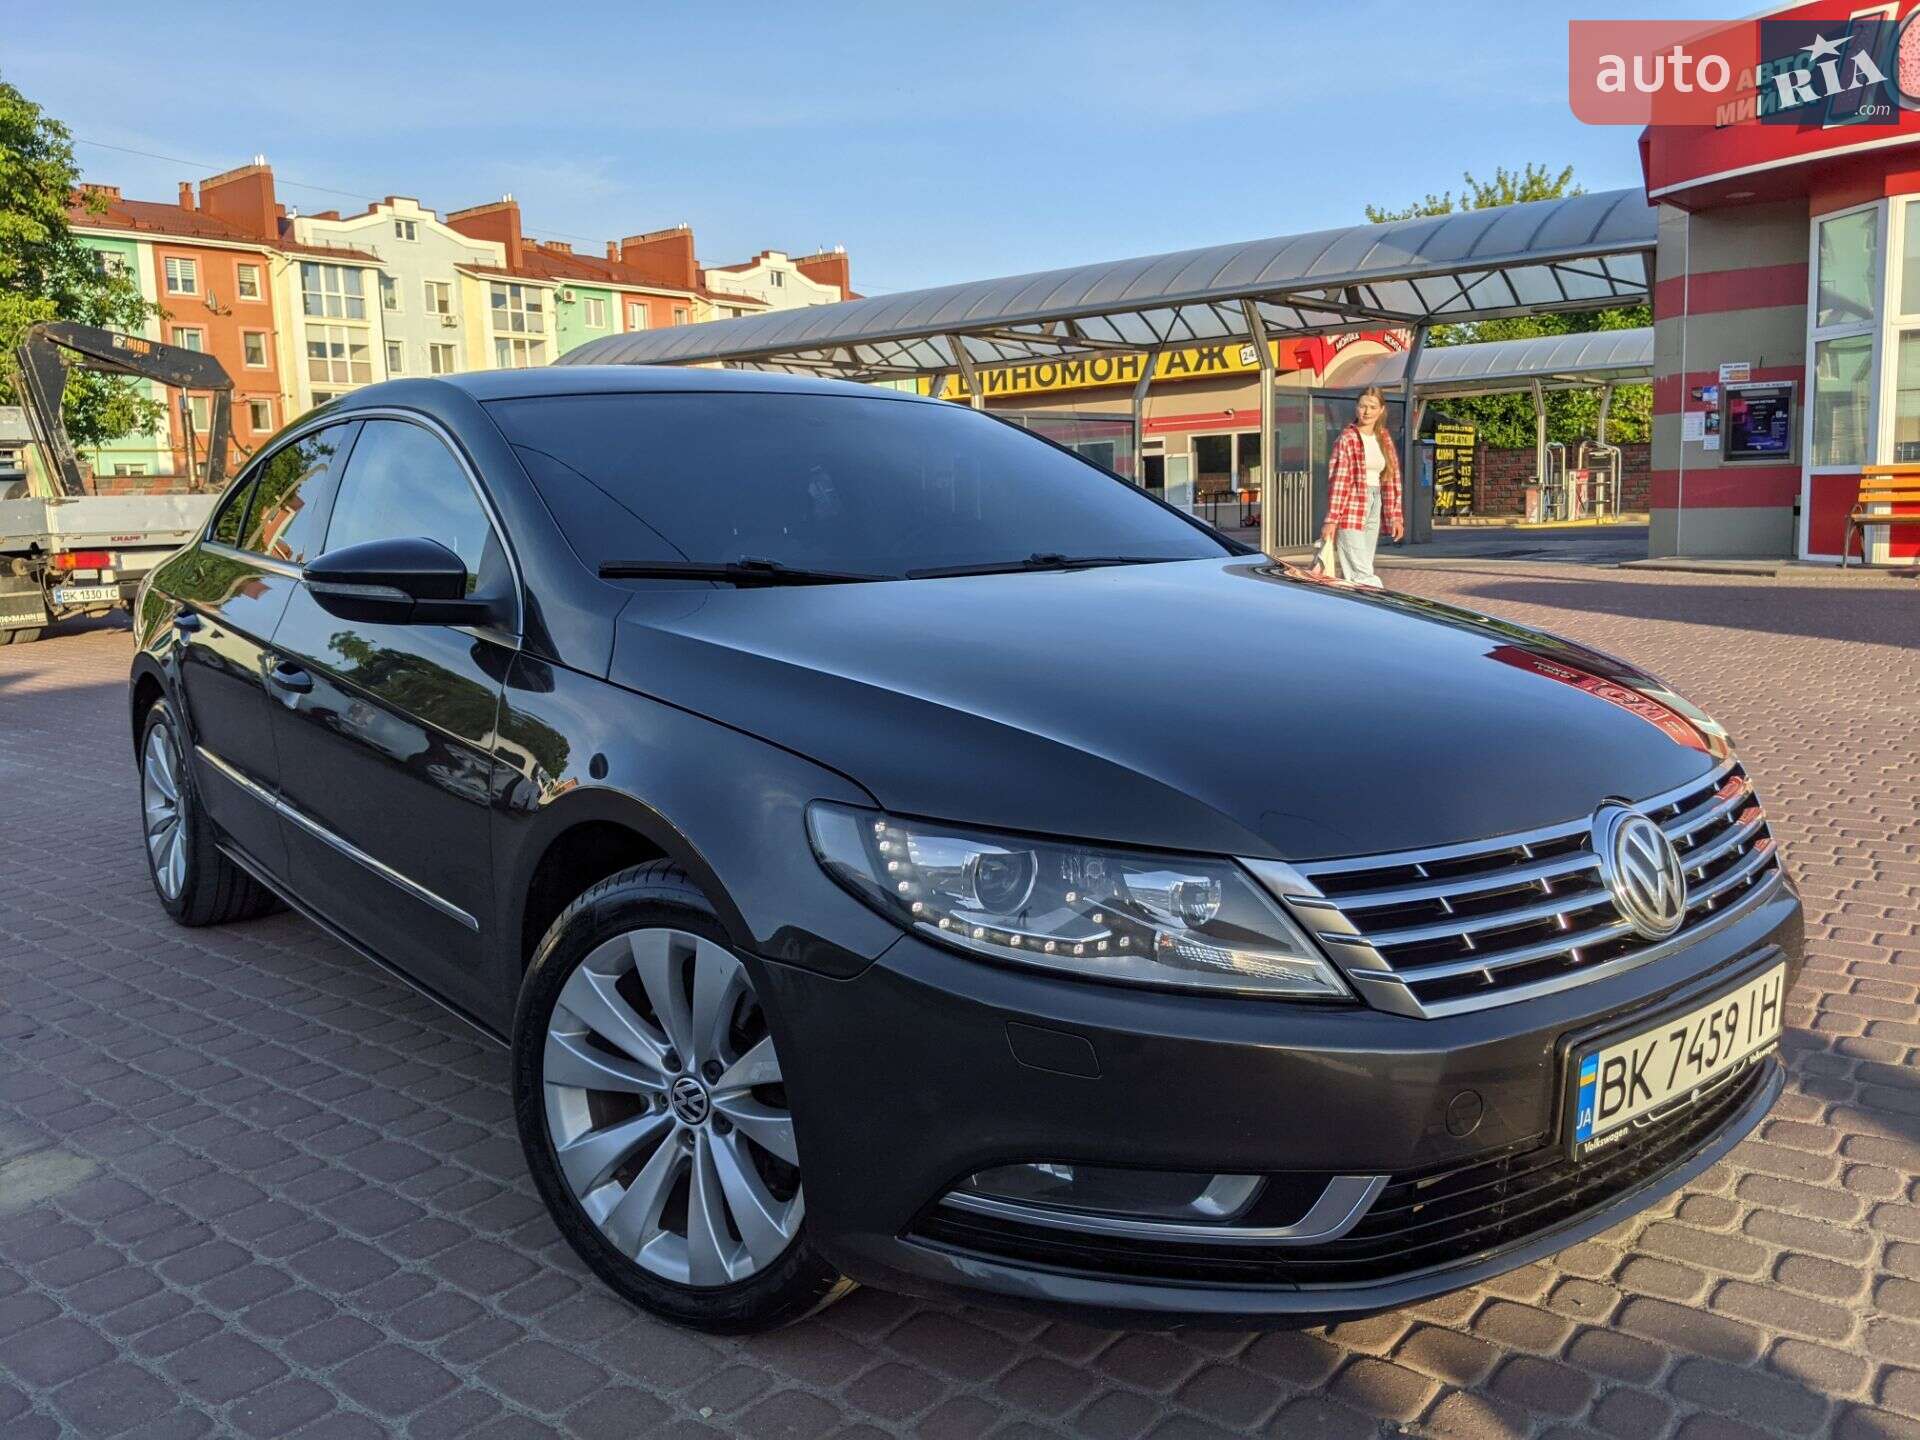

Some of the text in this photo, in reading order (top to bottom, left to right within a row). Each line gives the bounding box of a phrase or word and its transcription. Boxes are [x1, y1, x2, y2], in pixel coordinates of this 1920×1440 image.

[127, 337, 151, 354] HIAB
[958, 346, 1229, 395] ШИНОМОНАЖ
[63, 588, 118, 601] BK 1330 IC
[1598, 976, 1780, 1120] BK 7459 IH
[1584, 1127, 1628, 1152] Volkswagen
